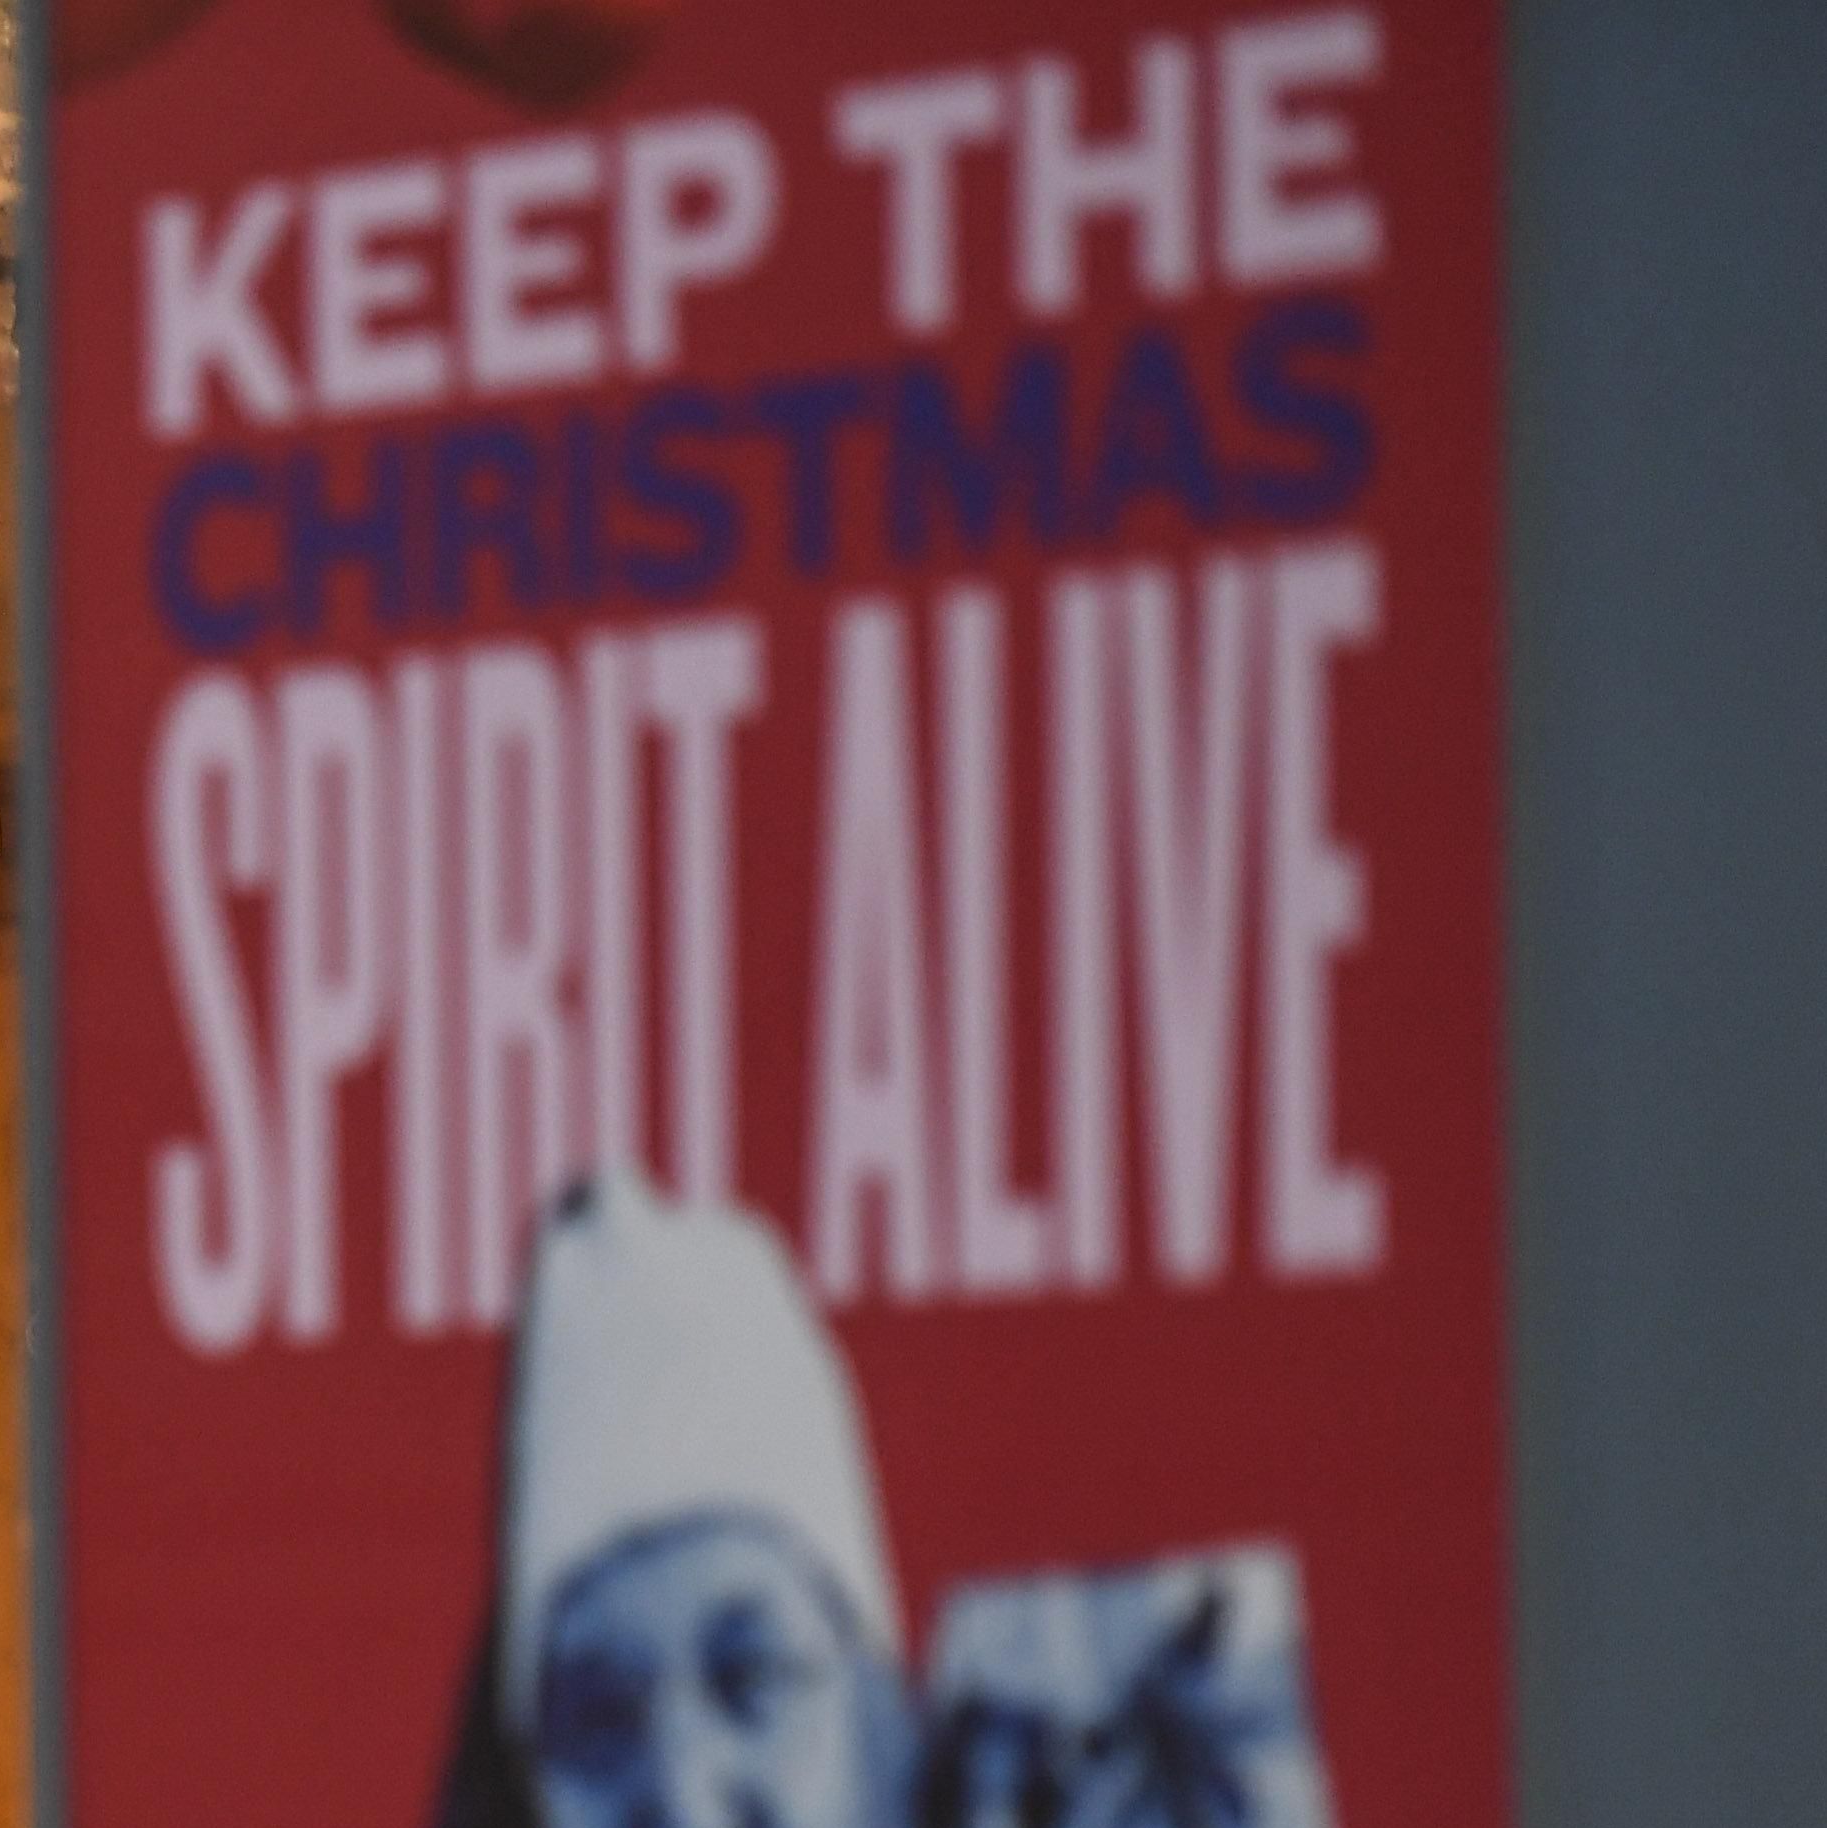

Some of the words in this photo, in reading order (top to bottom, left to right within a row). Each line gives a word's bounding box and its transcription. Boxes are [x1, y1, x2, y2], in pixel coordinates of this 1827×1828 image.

[145, 112, 780, 436] KEEP
[830, 12, 1385, 336] THE
[157, 294, 1377, 656] CHRISTMAS
[153, 613, 763, 1356] SPIRIT
[813, 537, 1385, 1308] ALIVE
